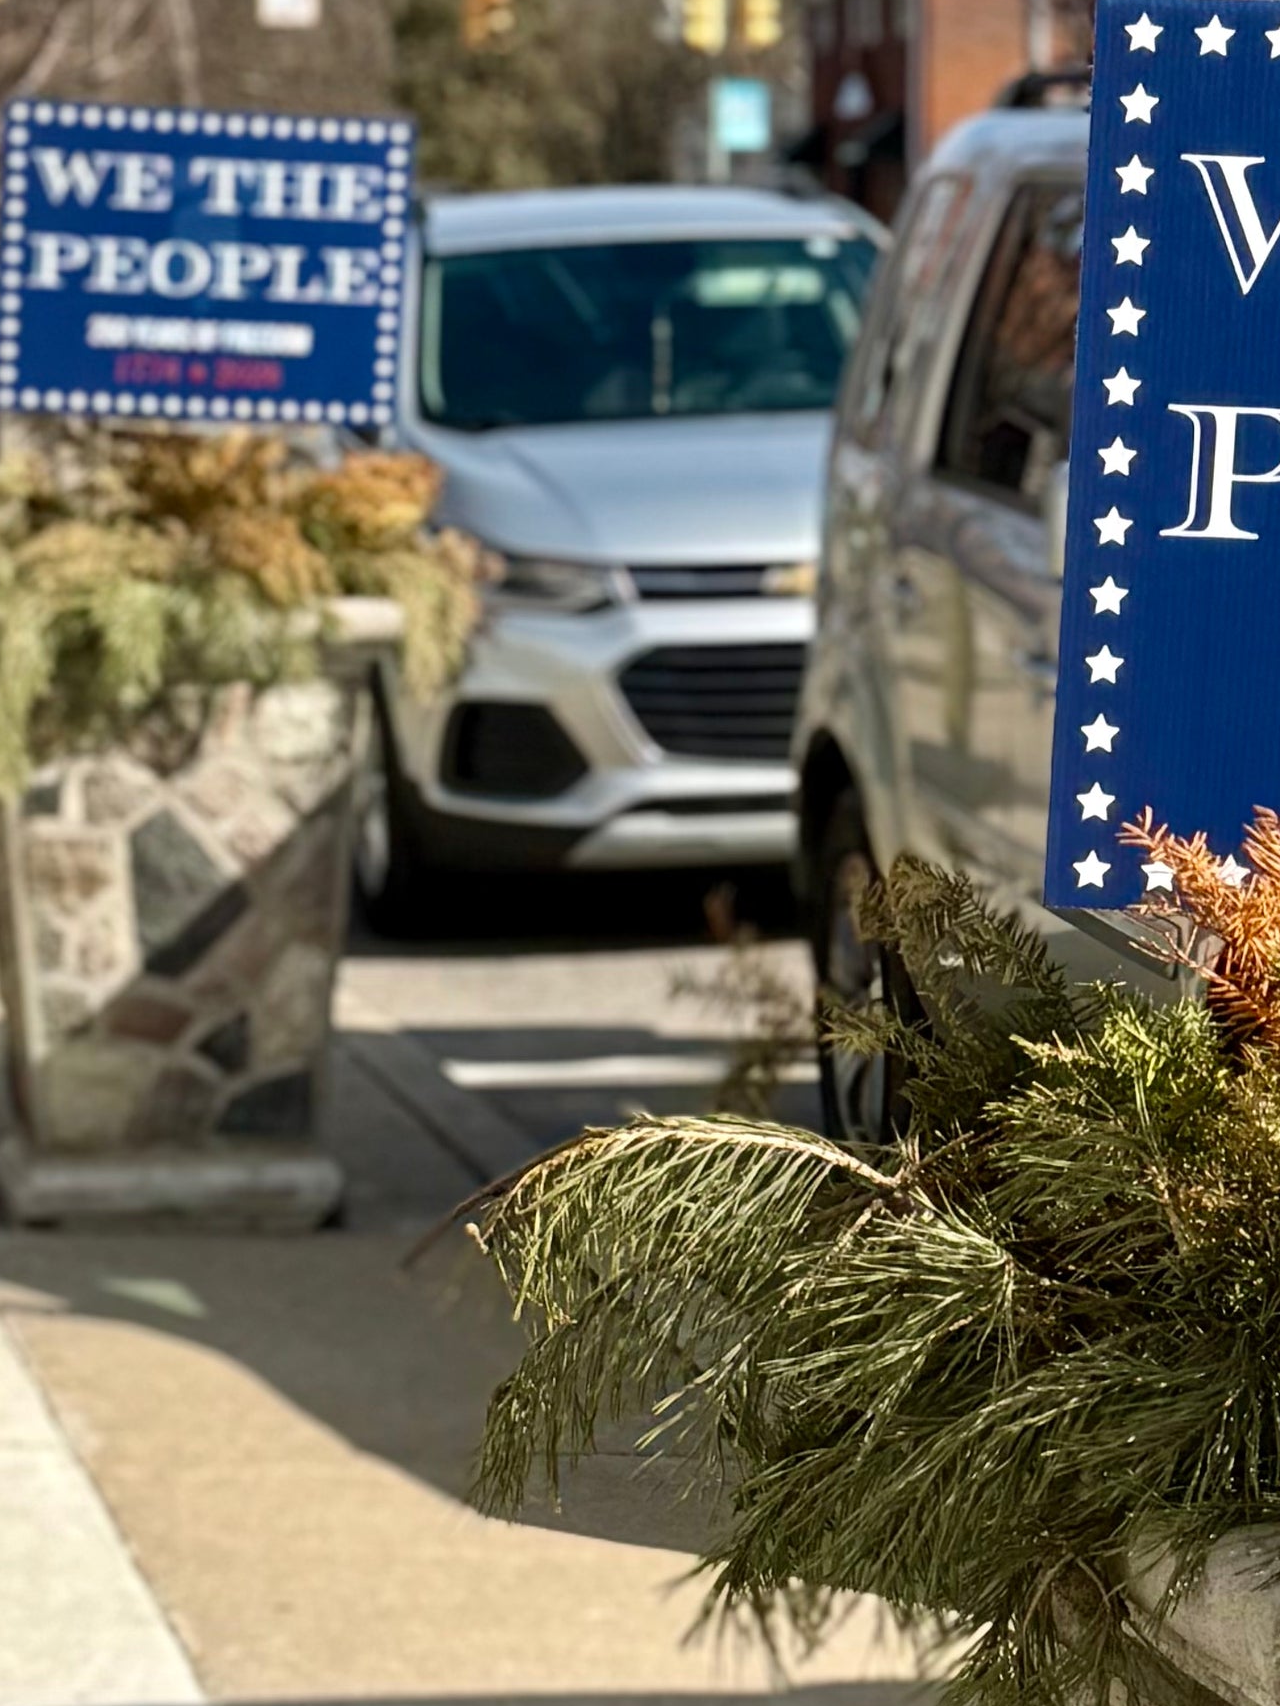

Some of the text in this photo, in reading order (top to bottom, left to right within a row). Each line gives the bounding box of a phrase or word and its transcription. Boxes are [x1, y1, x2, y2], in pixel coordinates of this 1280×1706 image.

[33, 148, 384, 222] WE THE
[27, 233, 378, 305] PEOPLE
